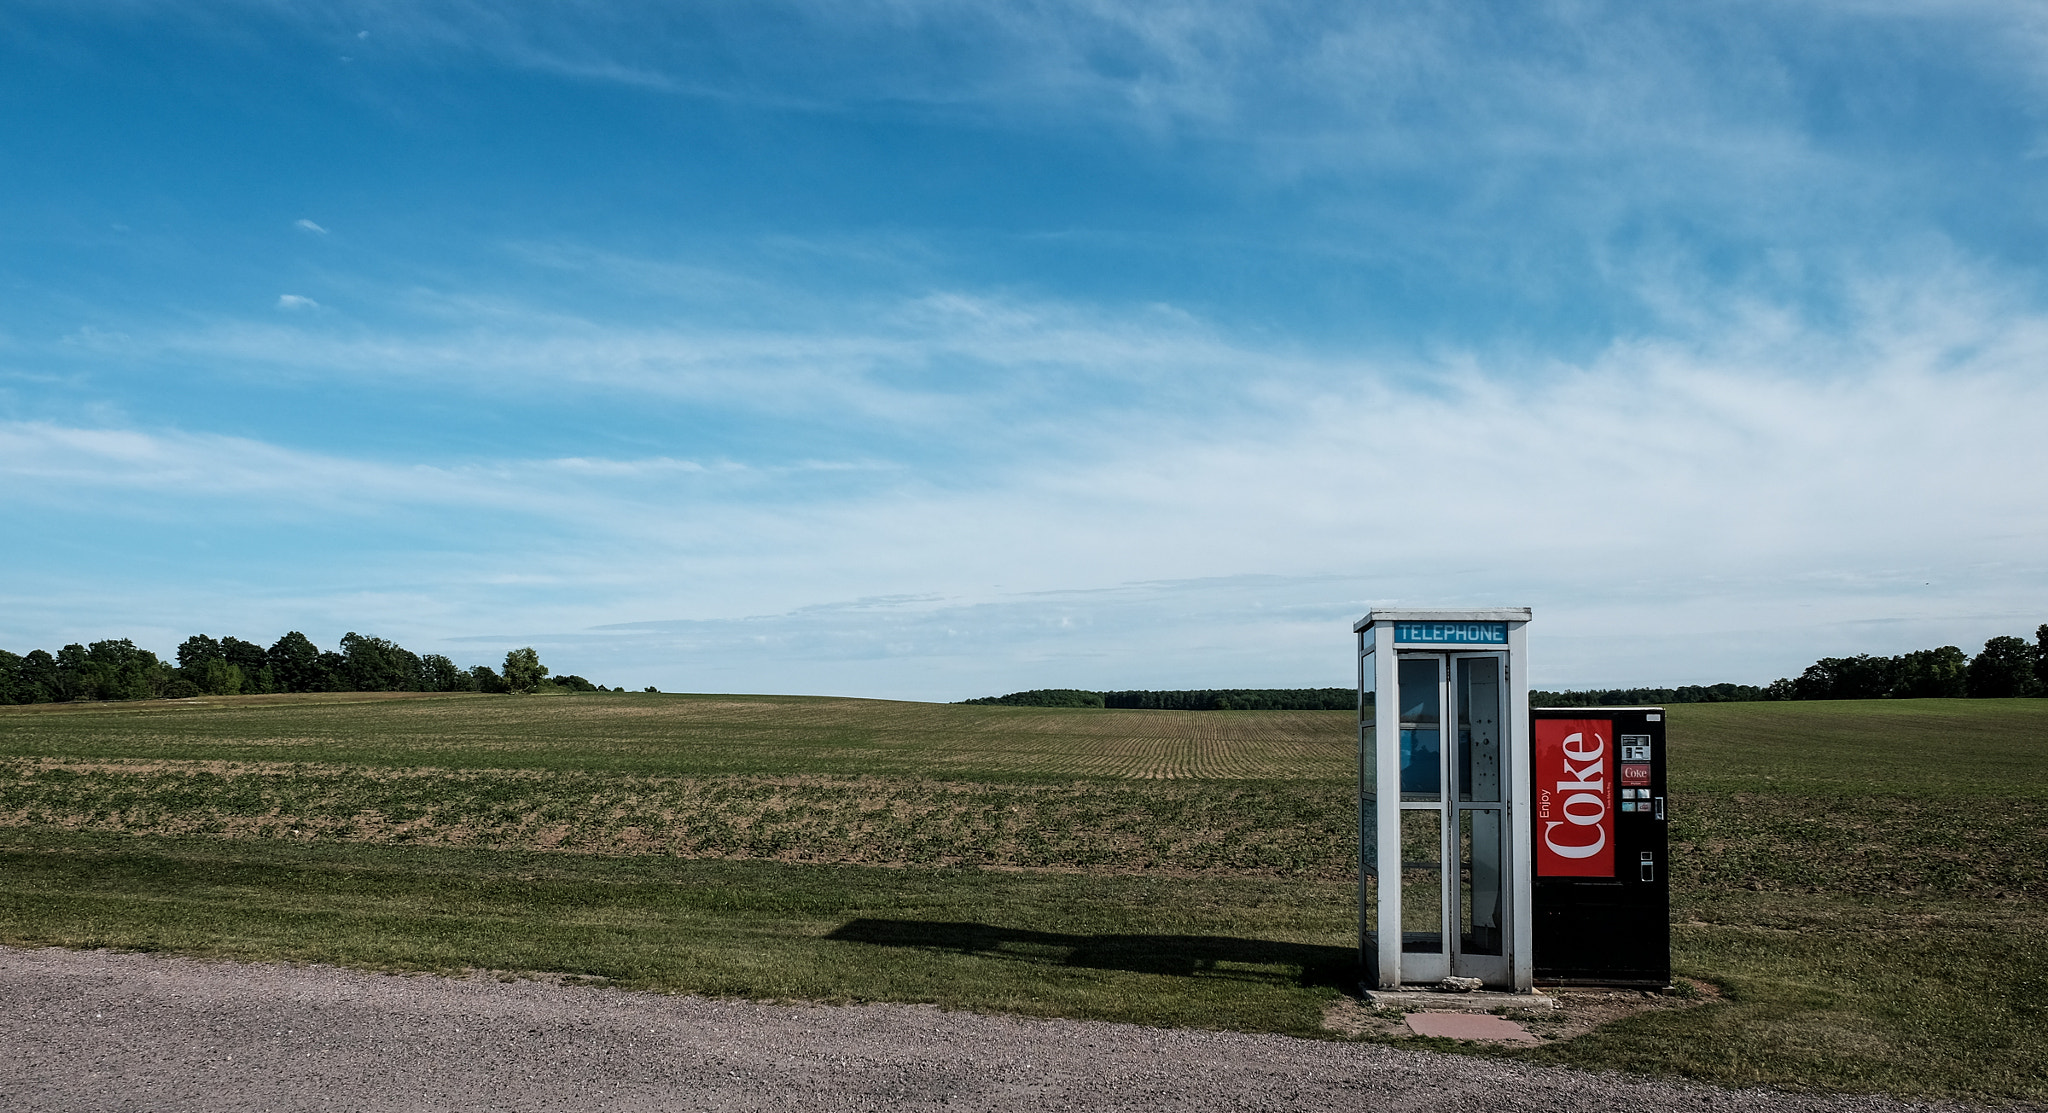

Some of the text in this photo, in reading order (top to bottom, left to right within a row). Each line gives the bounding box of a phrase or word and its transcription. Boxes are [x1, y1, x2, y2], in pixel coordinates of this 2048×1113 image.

[1398, 624, 1504, 641] TELEPHONE
[1624, 767, 1648, 778] Coke
[1539, 789, 1552, 819] Enjoy
[1544, 732, 1606, 859] Coke
